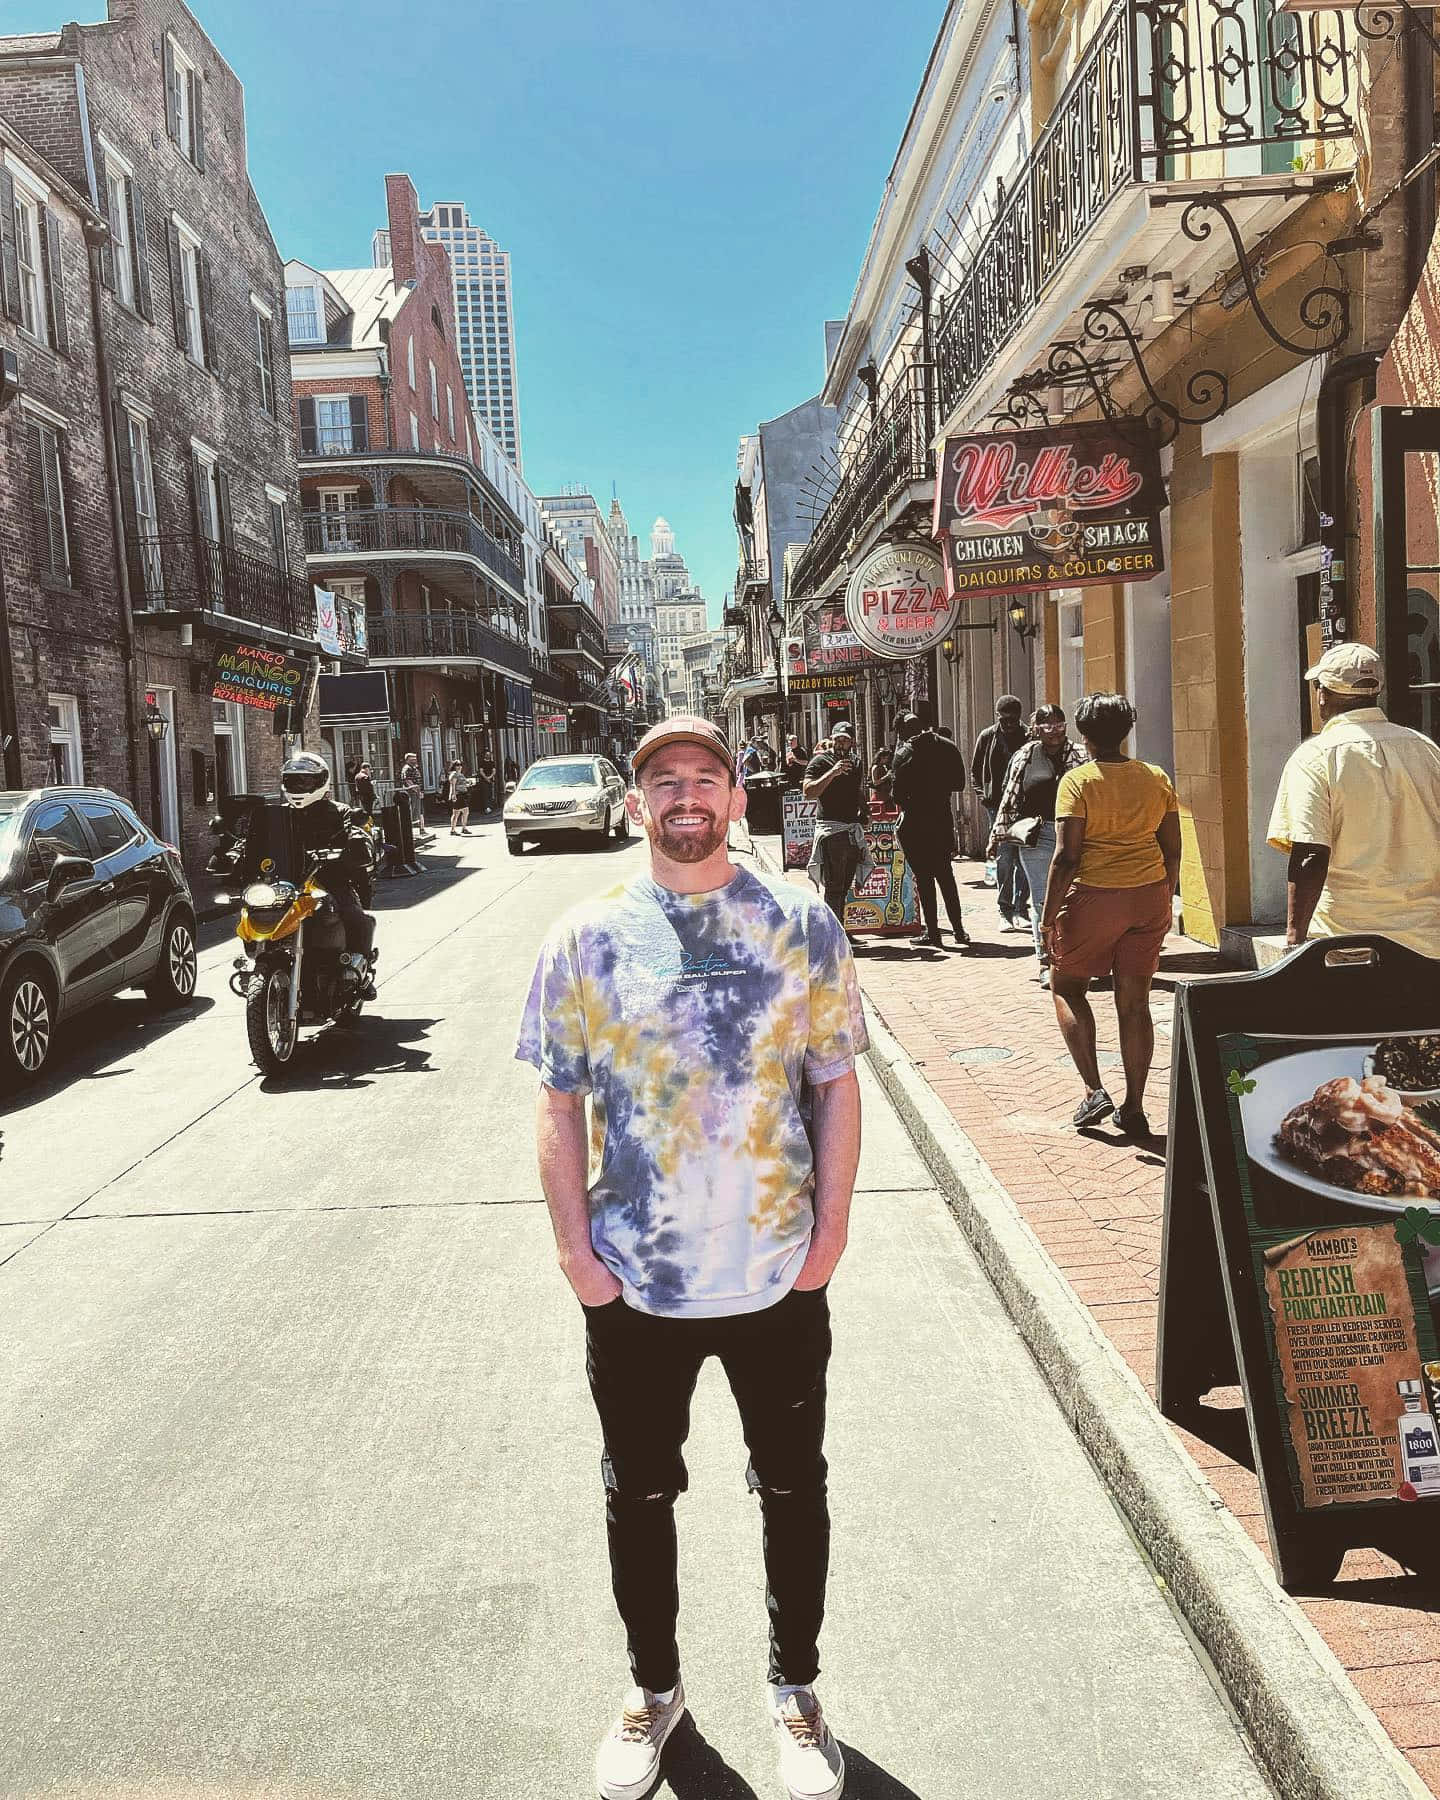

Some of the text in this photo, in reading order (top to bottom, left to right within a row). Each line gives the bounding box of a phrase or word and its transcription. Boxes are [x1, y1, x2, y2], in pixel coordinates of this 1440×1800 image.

[953, 441, 1143, 516] Willie's
[1084, 522, 1149, 547] SHACK
[956, 536, 1023, 560] CHICKEN
[915, 552, 937, 572] CITY
[959, 555, 1154, 588] DAIQUIRIS & COLD BEER
[862, 587, 950, 616] PIZZA
[877, 615, 935, 632] & BEER
[882, 633, 896, 643] NEW
[236, 646, 285, 665] MANGO
[217, 653, 301, 685] MANGO
[214, 682, 255, 697] COCKTAILS
[258, 691, 266, 700] &
[222, 671, 293, 697] DAIQUIRIS
[789, 676, 855, 689] PIZZA BY THE SLIC
[213, 688, 236, 702] PIZZA
[784, 802, 817, 819] PIZZ
[1305, 1237, 1358, 1257] MAMBO'S
[1277, 1264, 1356, 1298] REDFISH
[1282, 1293, 1387, 1321] PONCHARTRAIN
[1287, 1318, 1402, 1336] FRESH GRILLED REDFISH SERVED
[1289, 1330, 1405, 1347] OVER OUR HOMEMADE CRAWFISH
[1291, 1341, 1408, 1359] CORNBREAD DRESSING & TOPPED
[1292, 1355, 1385, 1371] WITH OUR SHRIMP LEMON
[1295, 1370, 1350, 1383] BUTTER SAUCE.
[1298, 1384, 1361, 1409] SUMMER
[1303, 1406, 1374, 1440] BREEZE
[1308, 1436, 1397, 1452] 1800 TEQUILA INFUSED WITH
[1408, 1438, 1433, 1450] 1800
[1310, 1448, 1387, 1462] FRESH STRAWBERRIES &
[1311, 1457, 1395, 1473] MINT CHILLED WITH TRULY
[1314, 1469, 1395, 1485] LEMONADE & MIXED WITH
[1315, 1480, 1394, 1495] FRESH TROPICAL JUICES.
